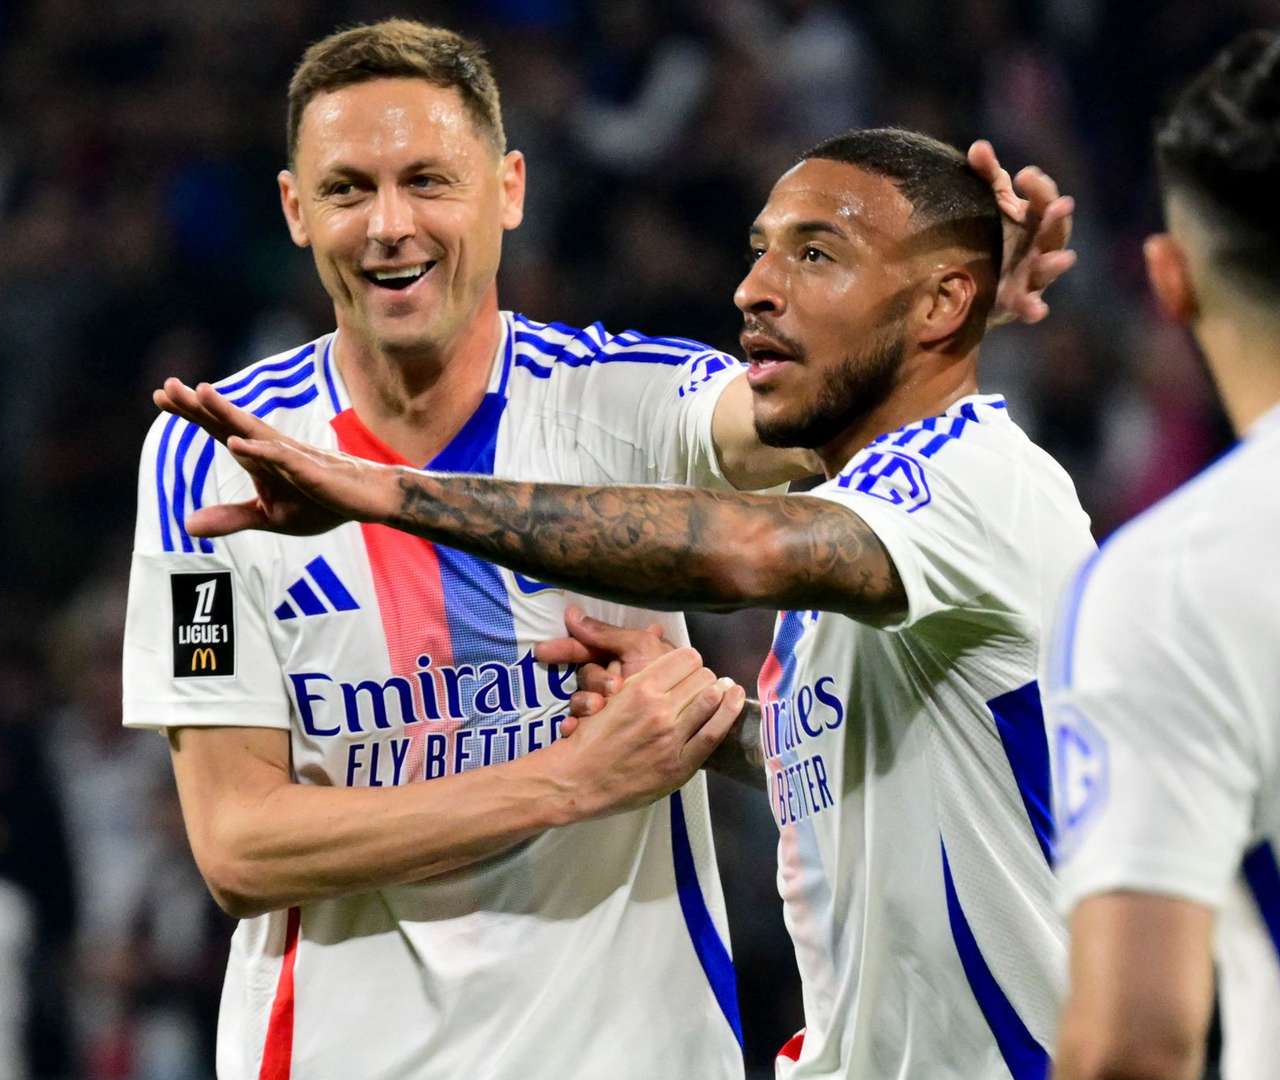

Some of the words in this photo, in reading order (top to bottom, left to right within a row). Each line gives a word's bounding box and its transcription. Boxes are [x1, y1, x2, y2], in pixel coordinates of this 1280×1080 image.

[289, 647, 580, 736] Emirate
[763, 676, 844, 759] irates
[346, 738, 410, 786] FLY
[777, 755, 834, 826] BETTER
